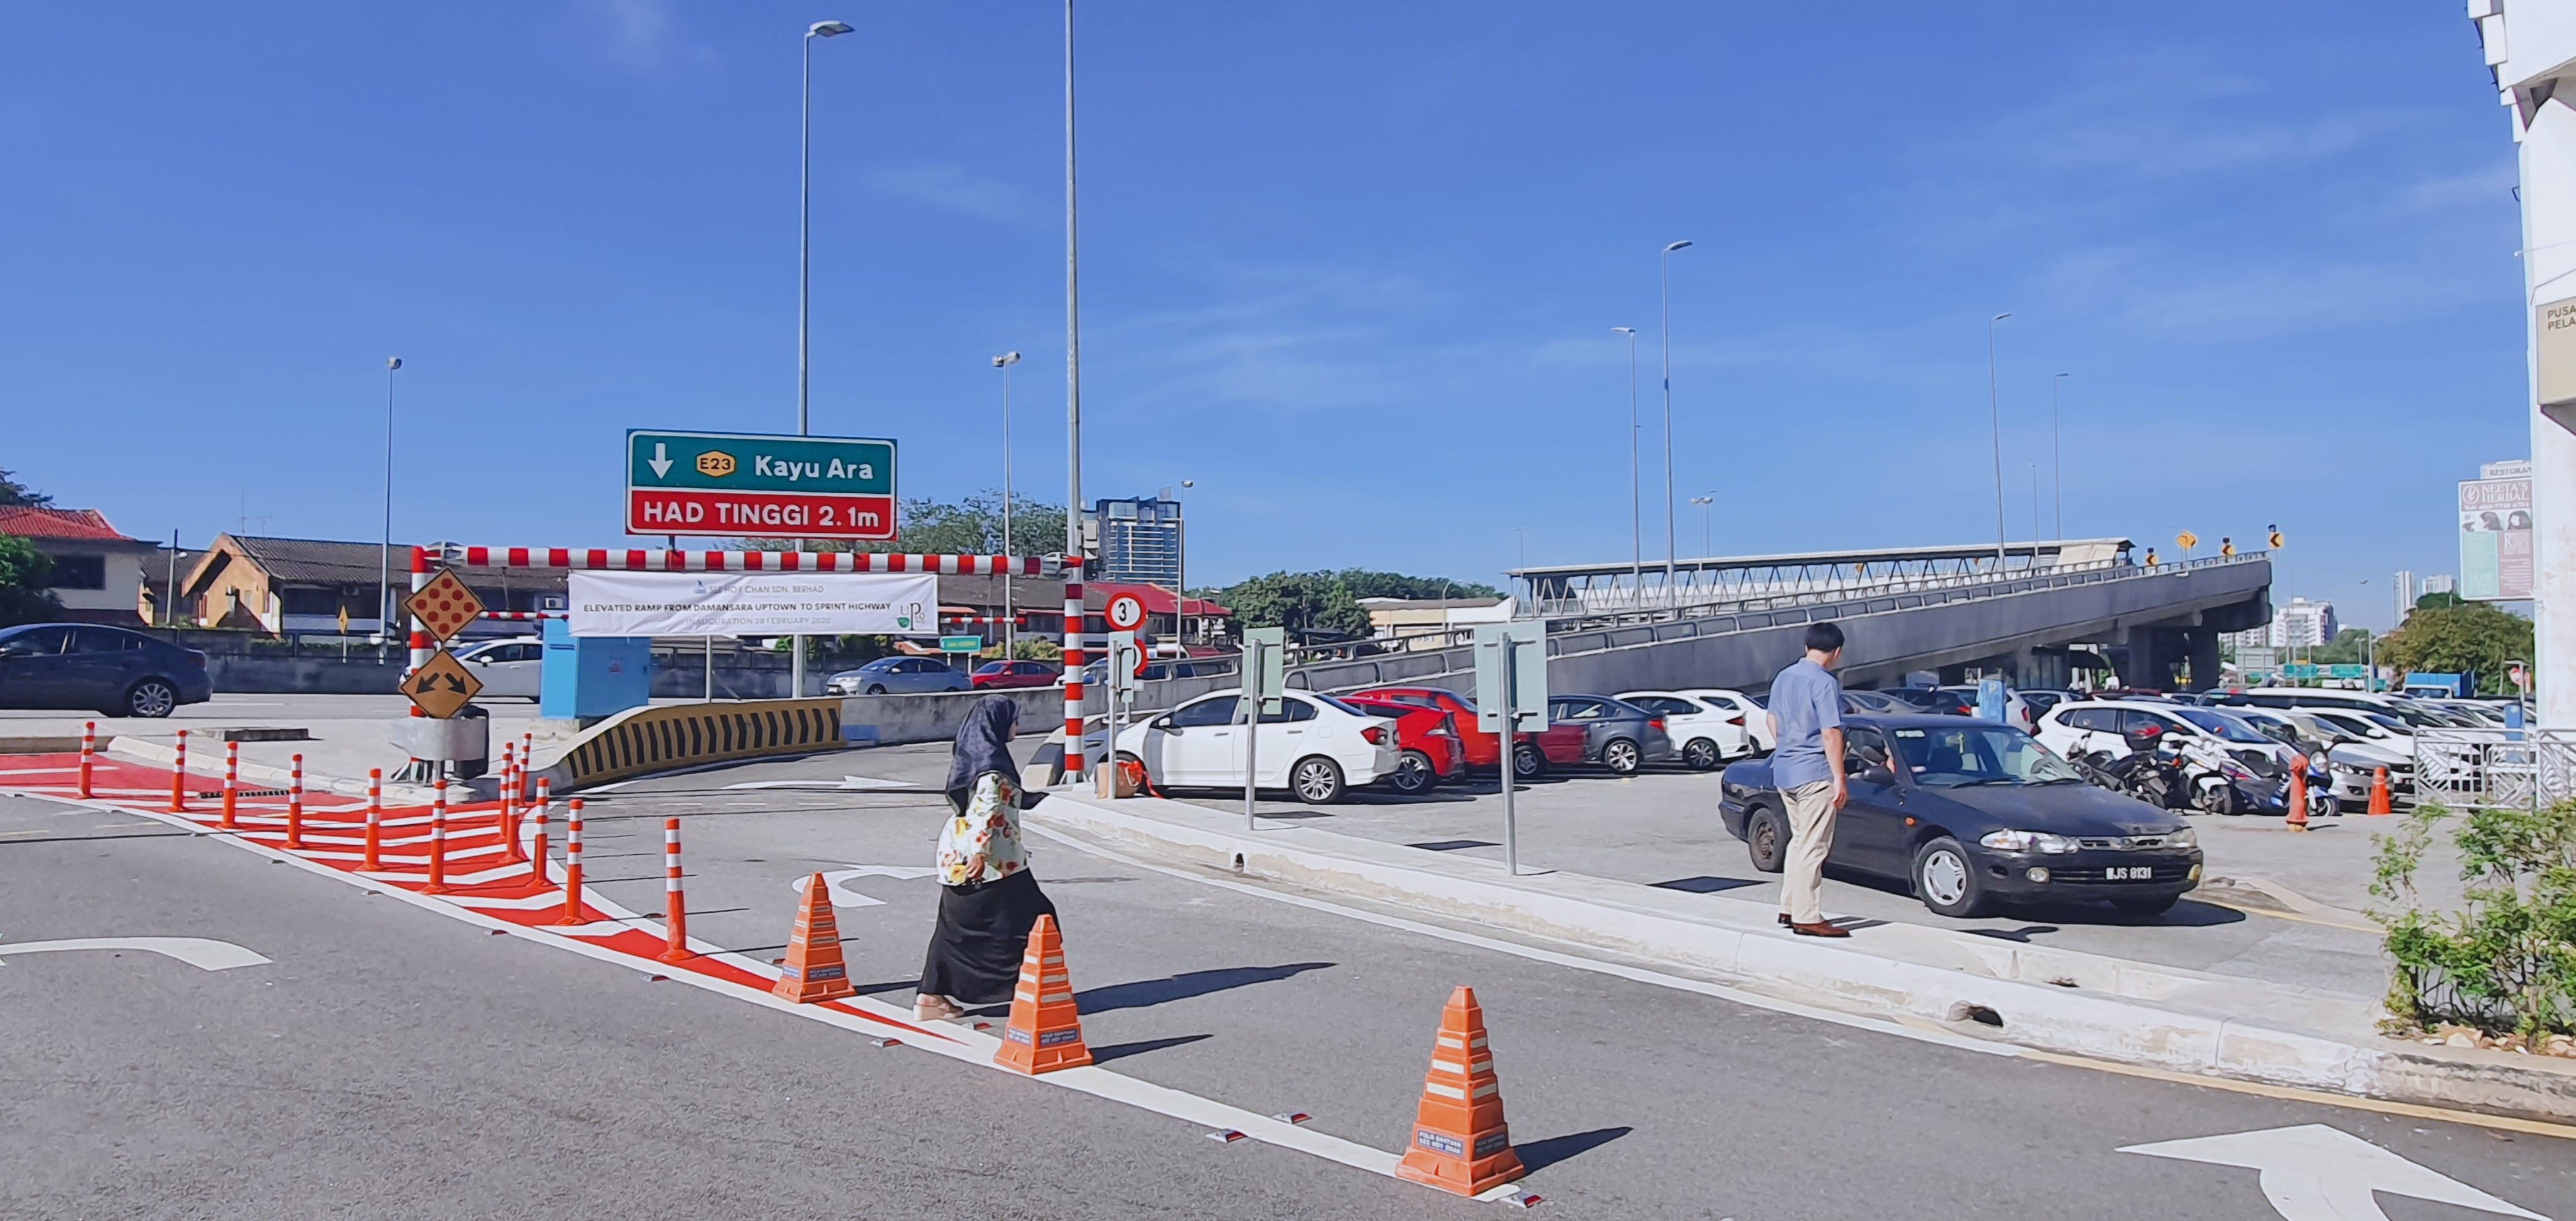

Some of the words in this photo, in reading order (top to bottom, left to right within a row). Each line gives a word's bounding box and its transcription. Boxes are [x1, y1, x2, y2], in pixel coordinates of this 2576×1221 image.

[700, 458, 731, 470] E23
[755, 455, 820, 481] Kayu
[827, 458, 873, 479] Ara
[2482, 491, 2529, 503] HERBAL
[644, 501, 705, 523] HAD
[715, 503, 809, 526] TINGGI
[709, 586, 722, 594] SEE
[584, 604, 632, 612] ELEVATED
[635, 604, 661, 612] RAMP
[815, 603, 846, 611] SPRINT
[849, 602, 891, 610] HIGHWAY
[686, 617, 753, 625] INAUGURATION
